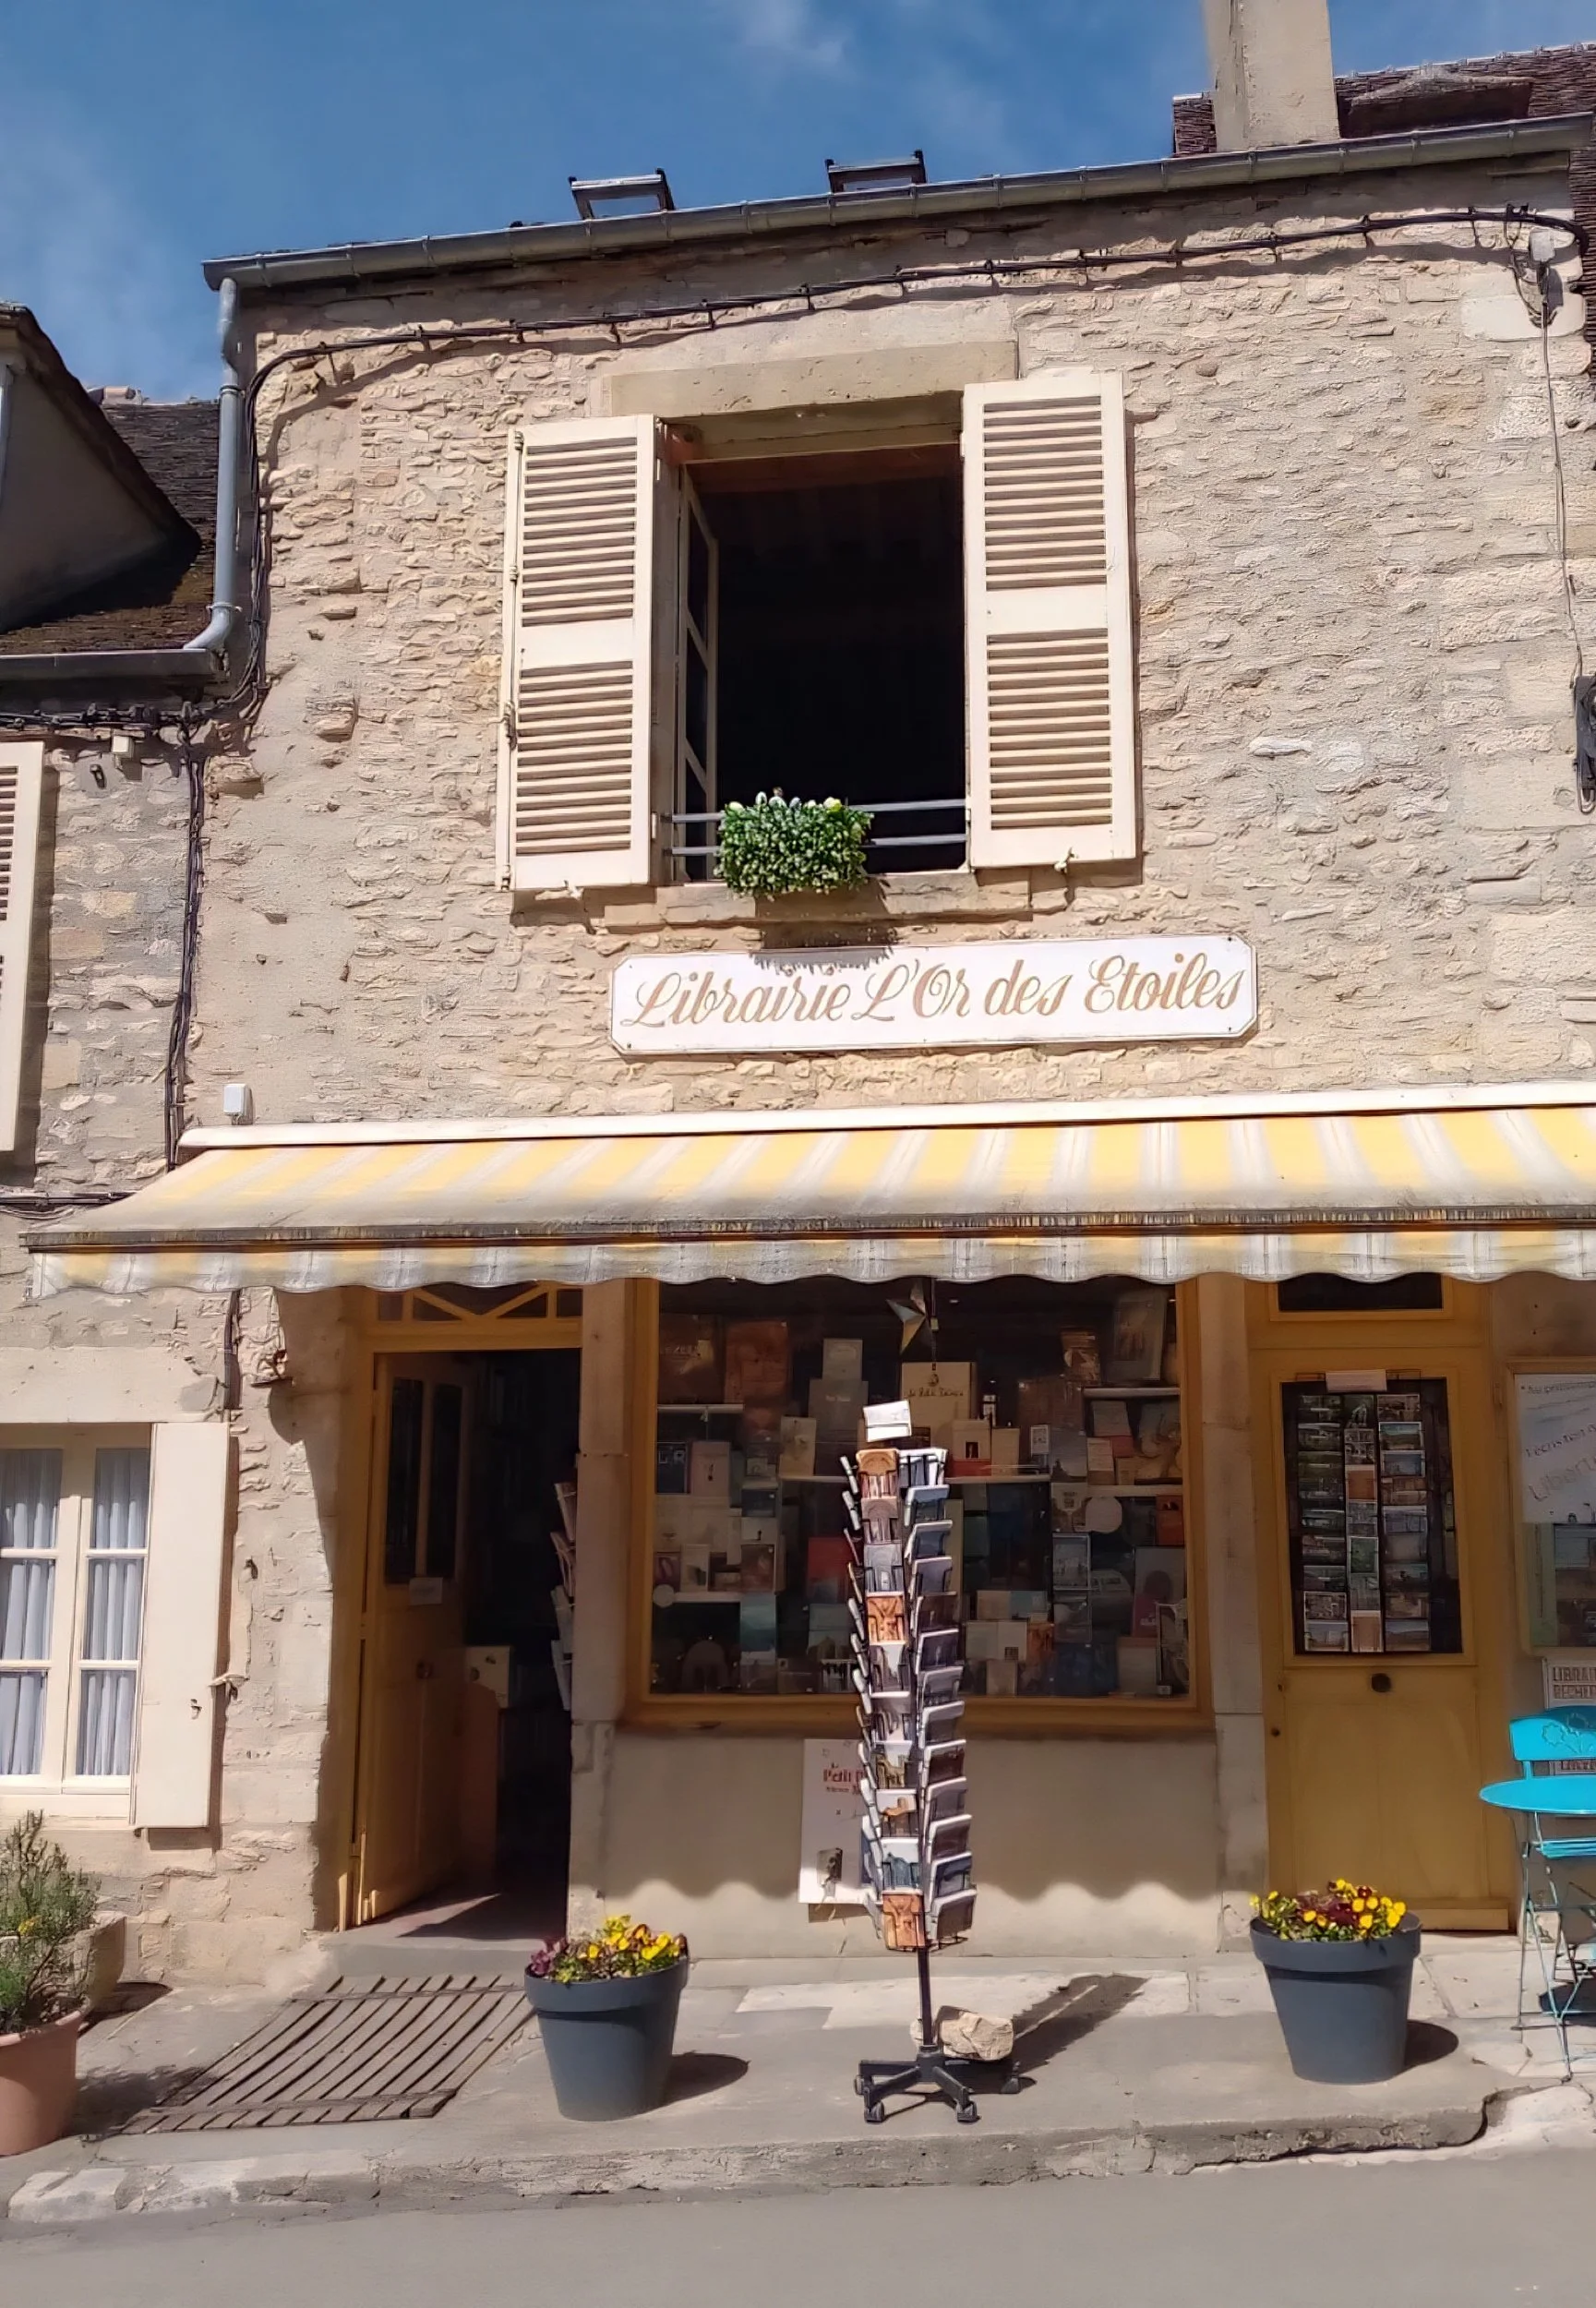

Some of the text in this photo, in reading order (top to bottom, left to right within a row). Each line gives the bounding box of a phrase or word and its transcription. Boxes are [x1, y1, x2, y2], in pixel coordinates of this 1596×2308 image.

[620, 952, 1247, 1028] Librairie L'Or des Etoiles
